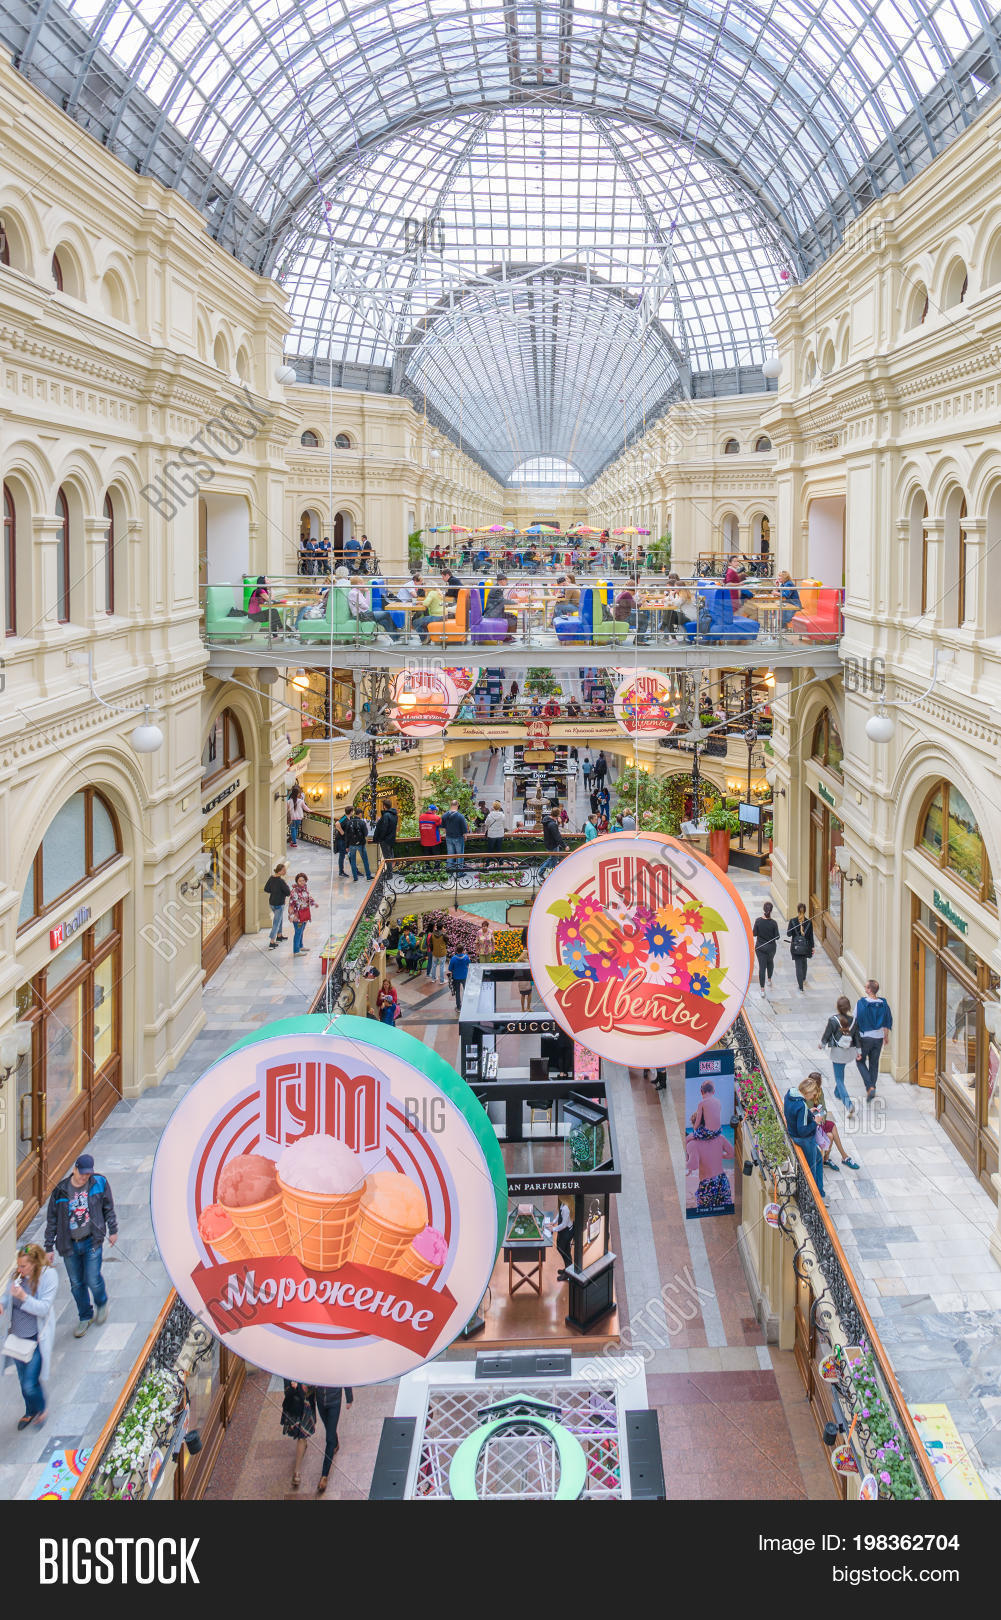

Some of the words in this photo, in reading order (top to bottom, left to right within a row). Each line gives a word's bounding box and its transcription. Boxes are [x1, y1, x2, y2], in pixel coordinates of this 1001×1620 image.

[599, 857, 673, 911] ГУМ
[507, 1022, 556, 1032] GUCCI
[562, 968, 708, 1031] Цветы
[266, 1062, 381, 1154] ГУМ
[524, 1182, 580, 1190] PARFUMEUR
[221, 1271, 434, 1332] Мороженое
